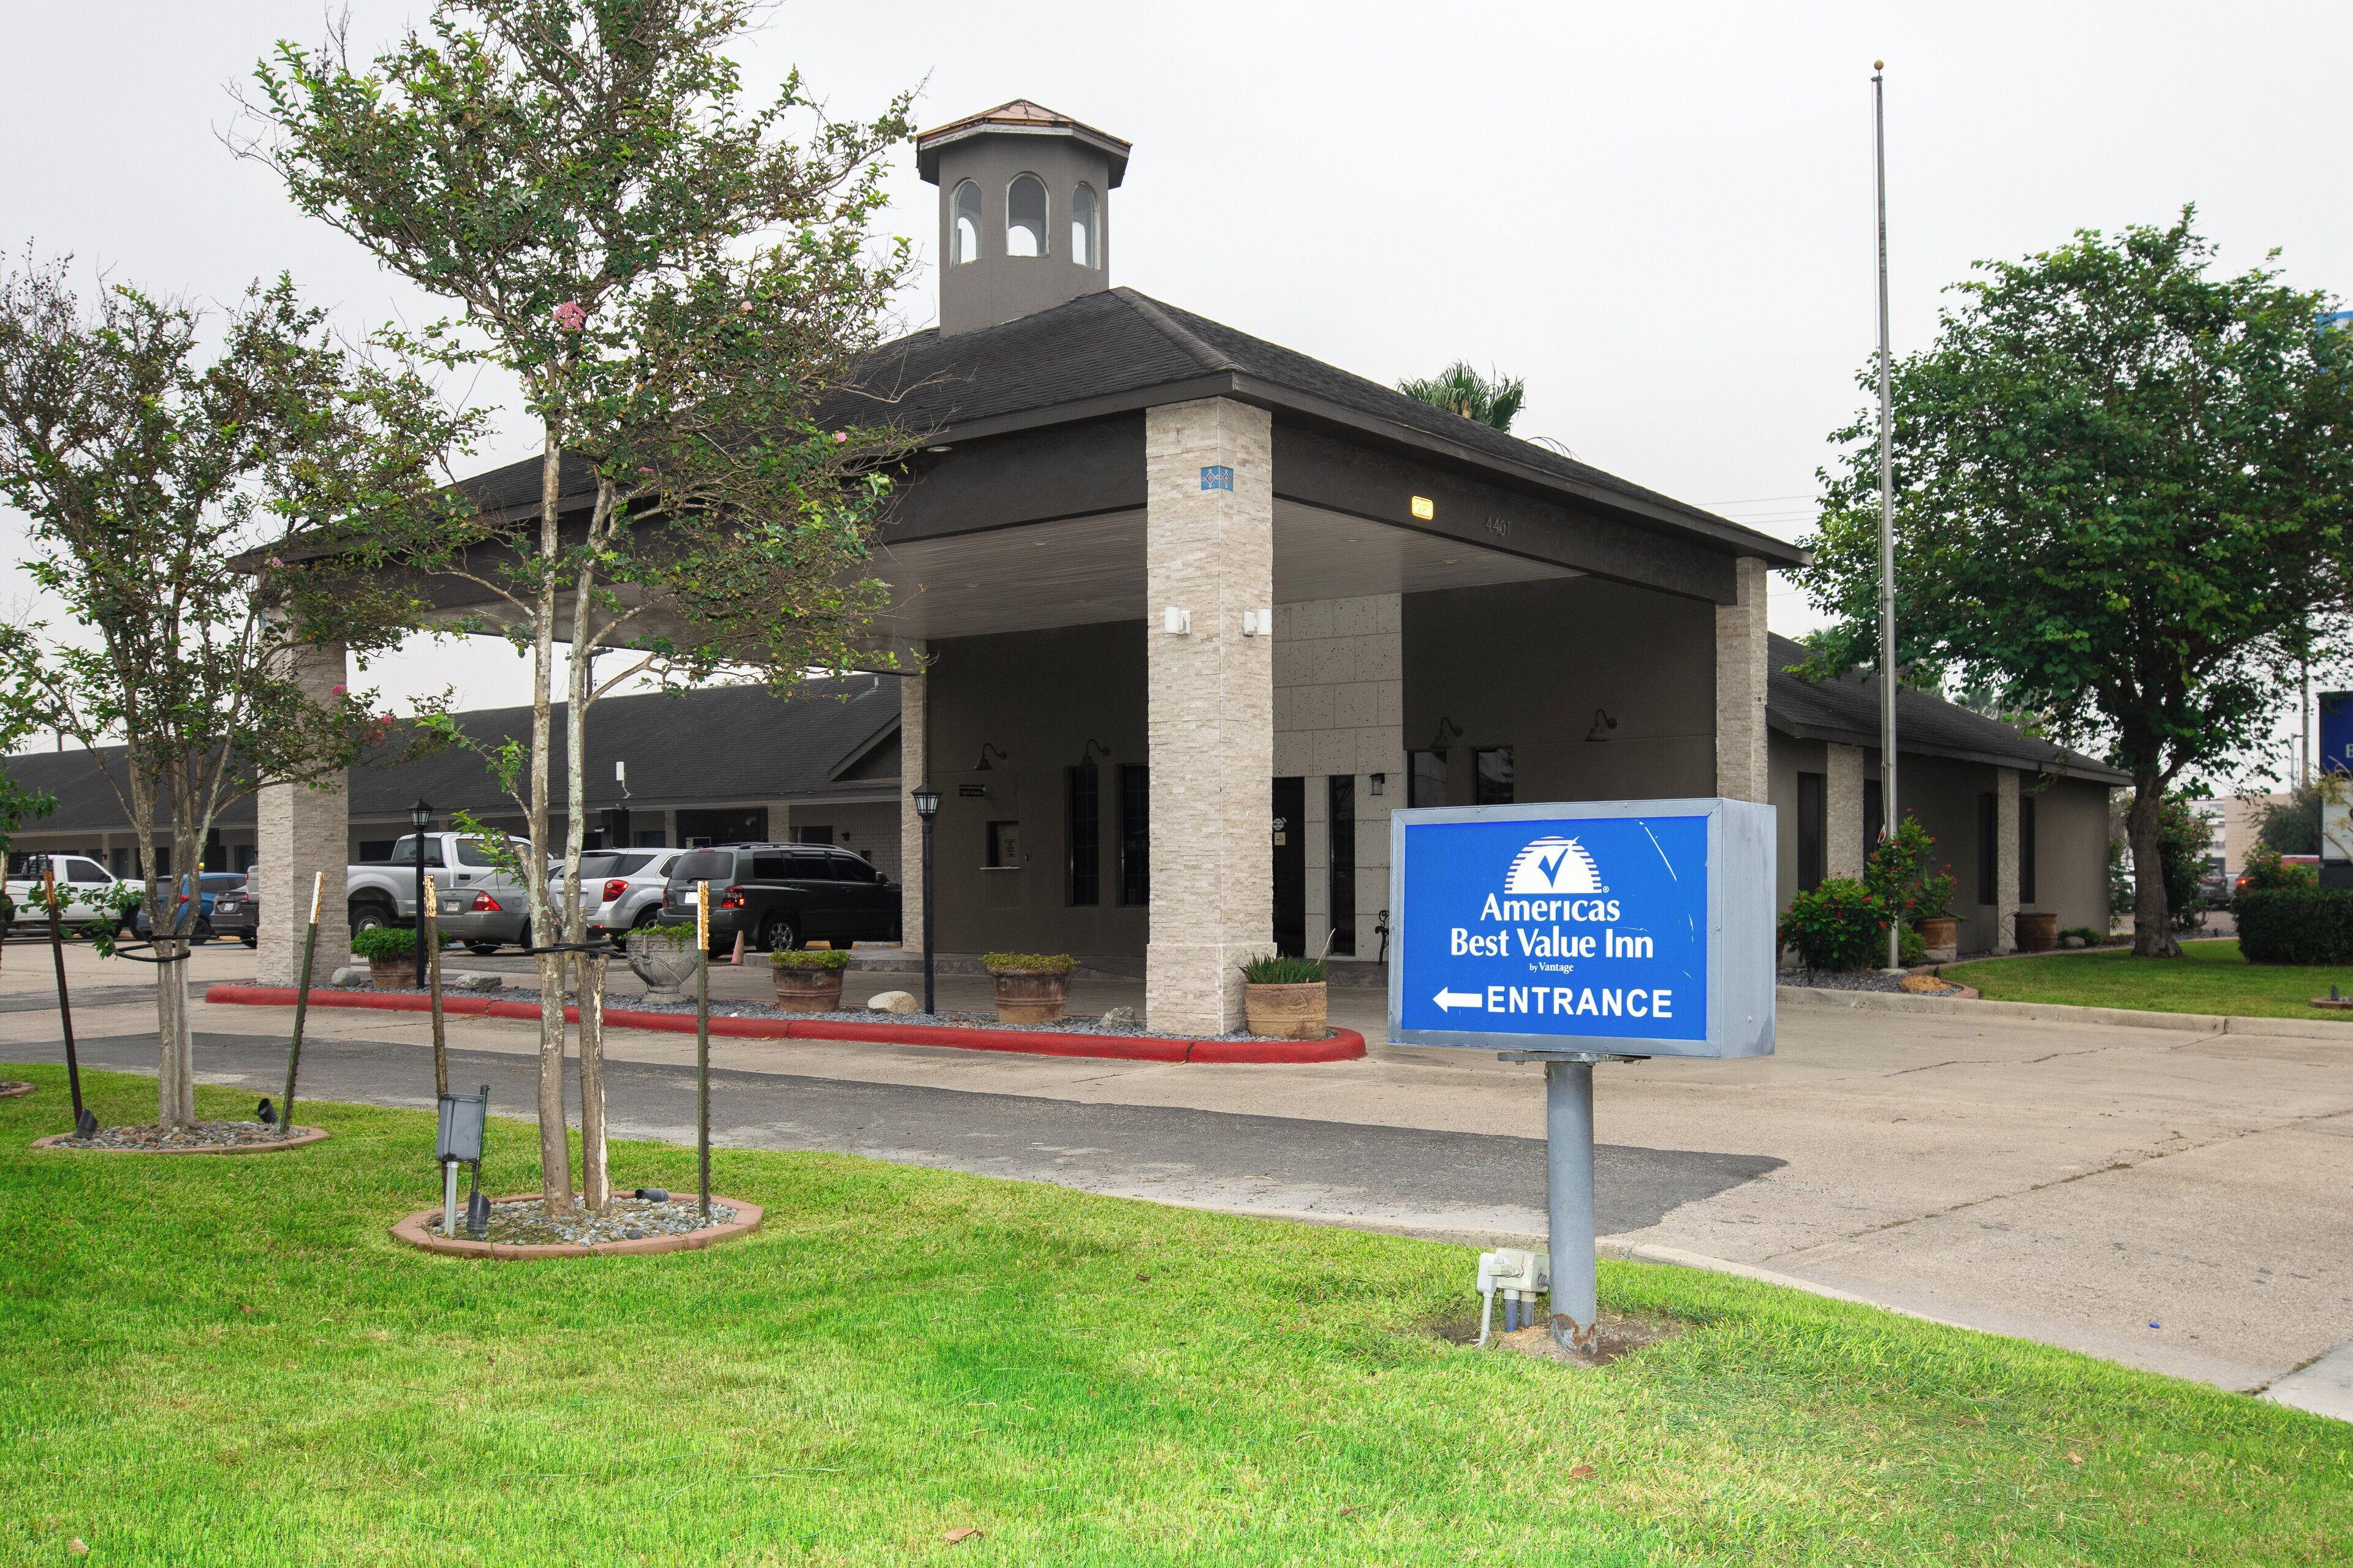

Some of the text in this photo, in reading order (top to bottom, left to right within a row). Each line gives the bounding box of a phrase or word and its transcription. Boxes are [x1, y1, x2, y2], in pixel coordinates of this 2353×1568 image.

[1486, 517, 1510, 536] 4401
[1480, 893, 1620, 922] Americas
[1451, 925, 1653, 958] Best Value Inn
[1529, 961, 1574, 974] by Vantage
[1488, 985, 1672, 1018] ENTRANCE
